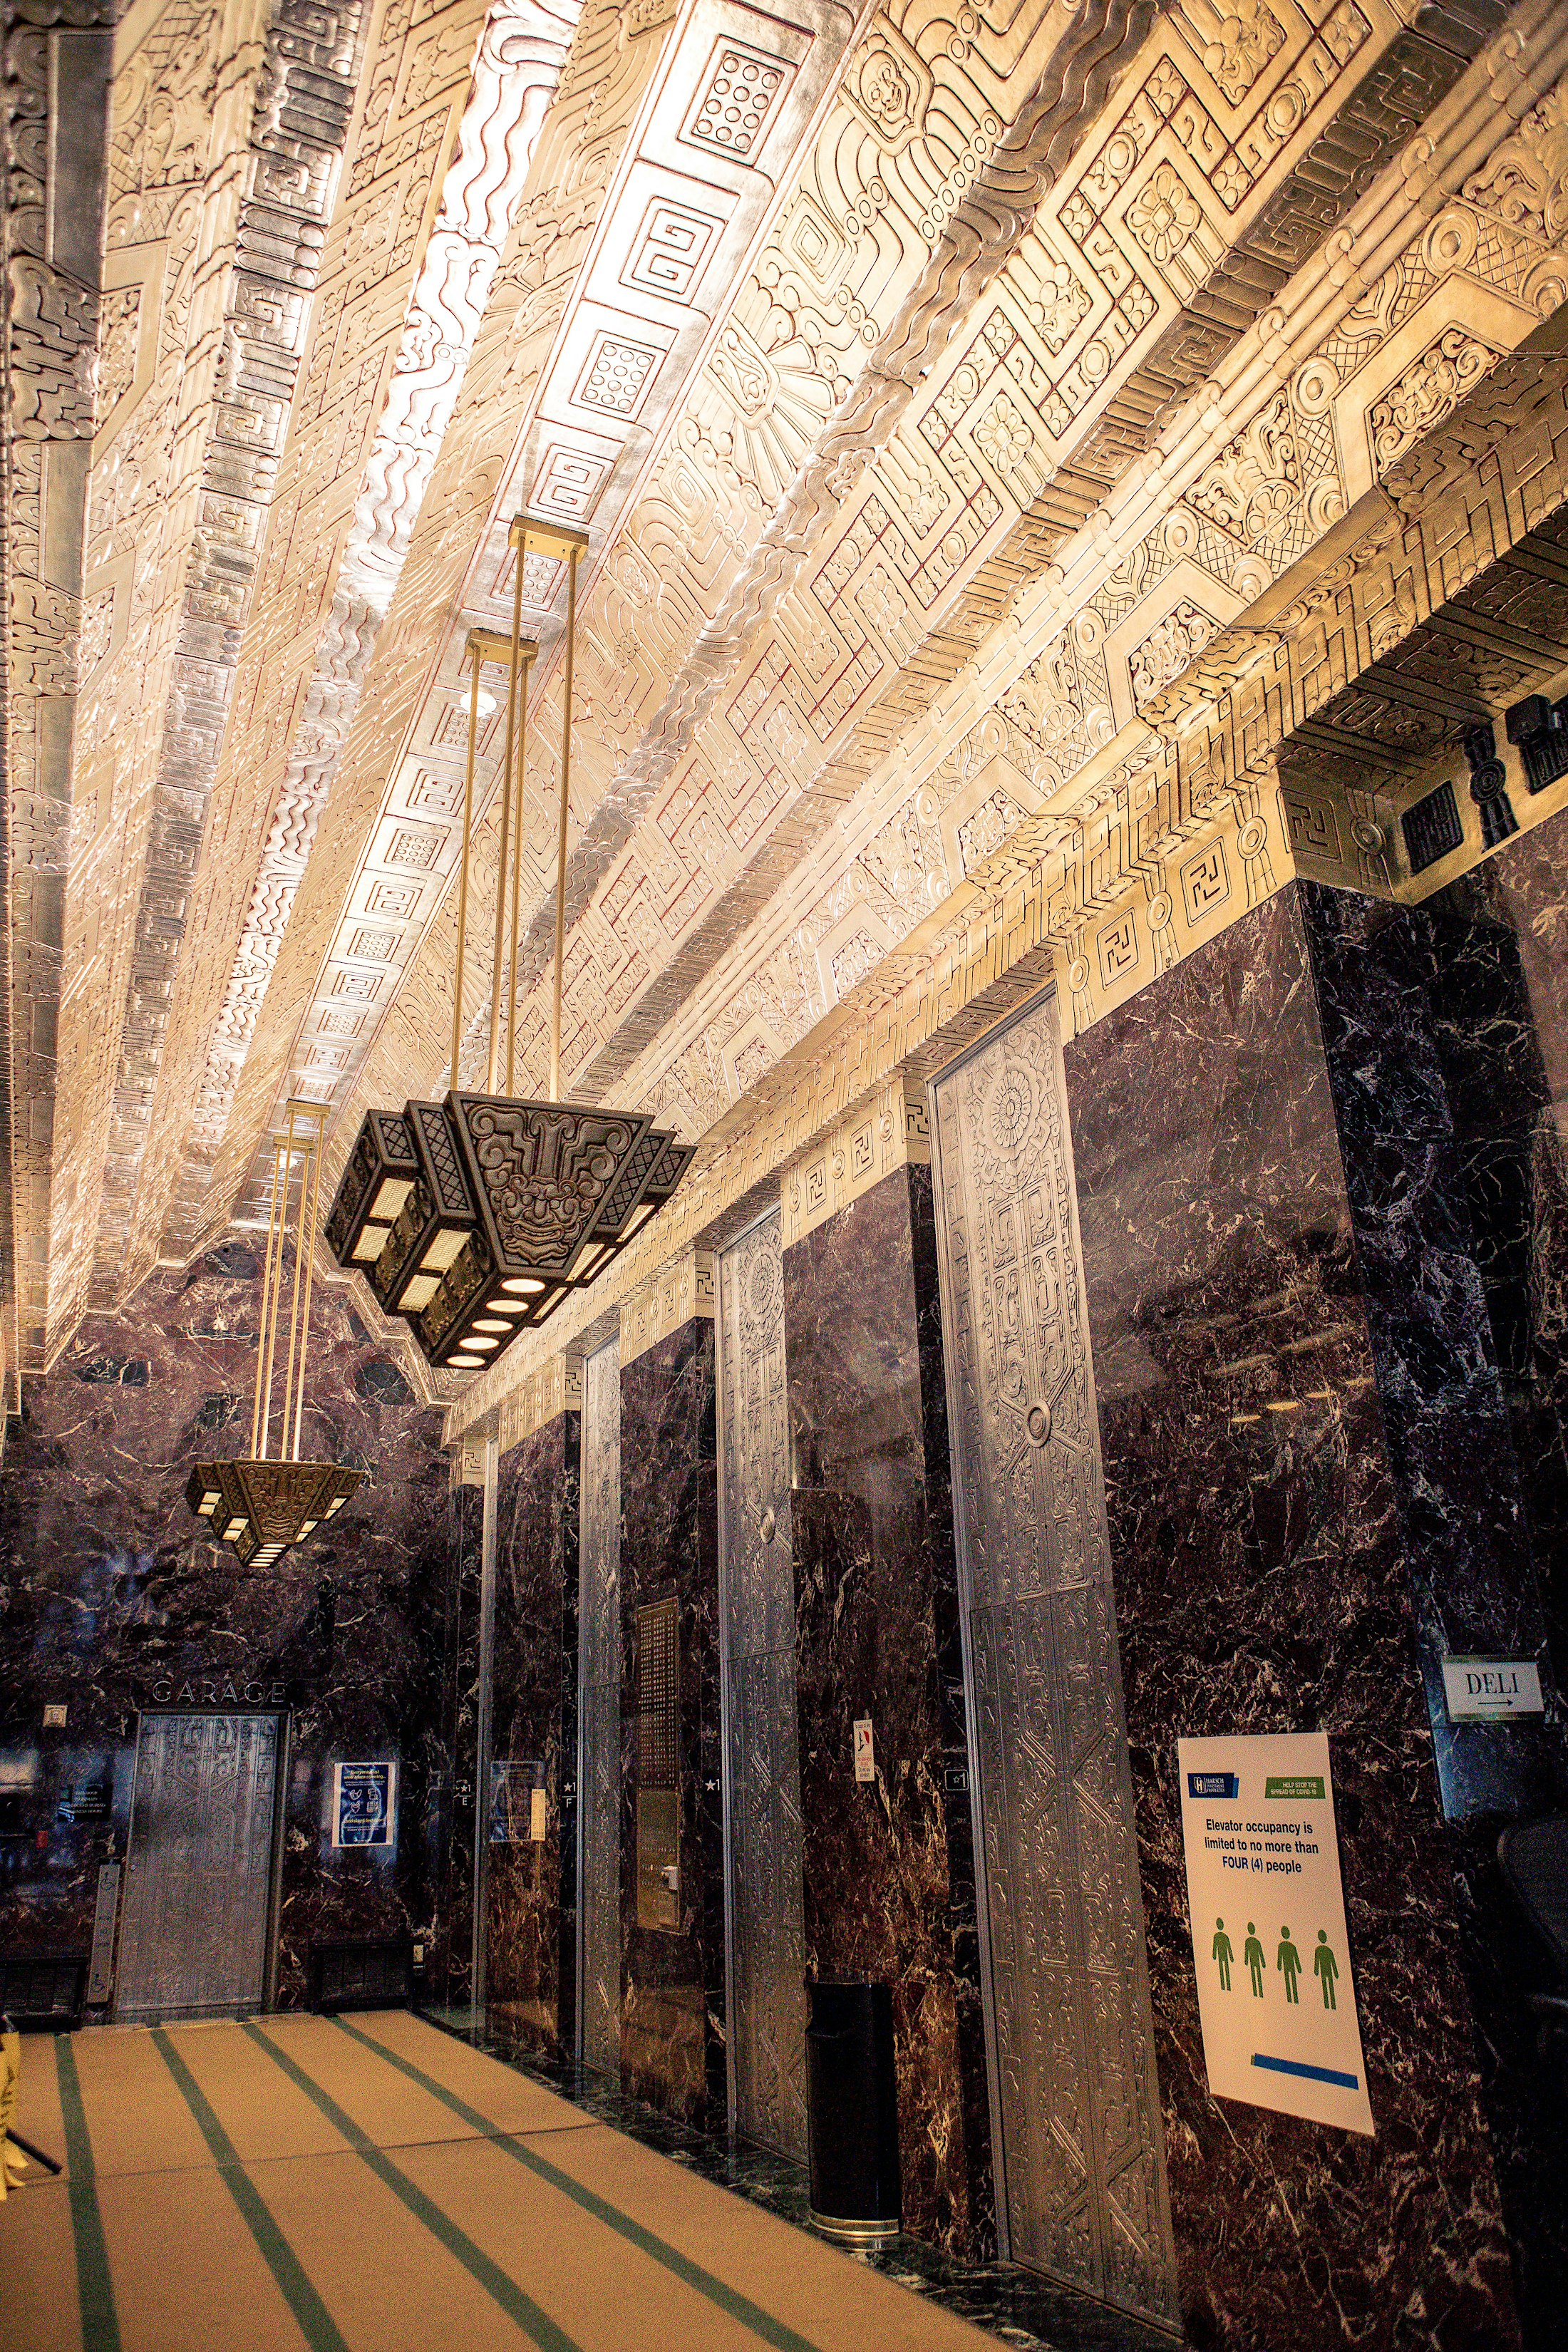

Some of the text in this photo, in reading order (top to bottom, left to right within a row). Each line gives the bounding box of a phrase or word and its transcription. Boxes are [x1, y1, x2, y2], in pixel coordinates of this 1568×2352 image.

[152, 1680, 287, 1703] GARAGE
[1465, 1672, 1520, 1694] DELI
[463, 1797, 468, 1805] E
[566, 1798, 572, 1807] F
[1206, 1818, 1313, 1836] Elevator occupancy is
[1205, 1836, 1319, 1855] limited to no more than
[1222, 1856, 1302, 1874] FOUR (4) people
